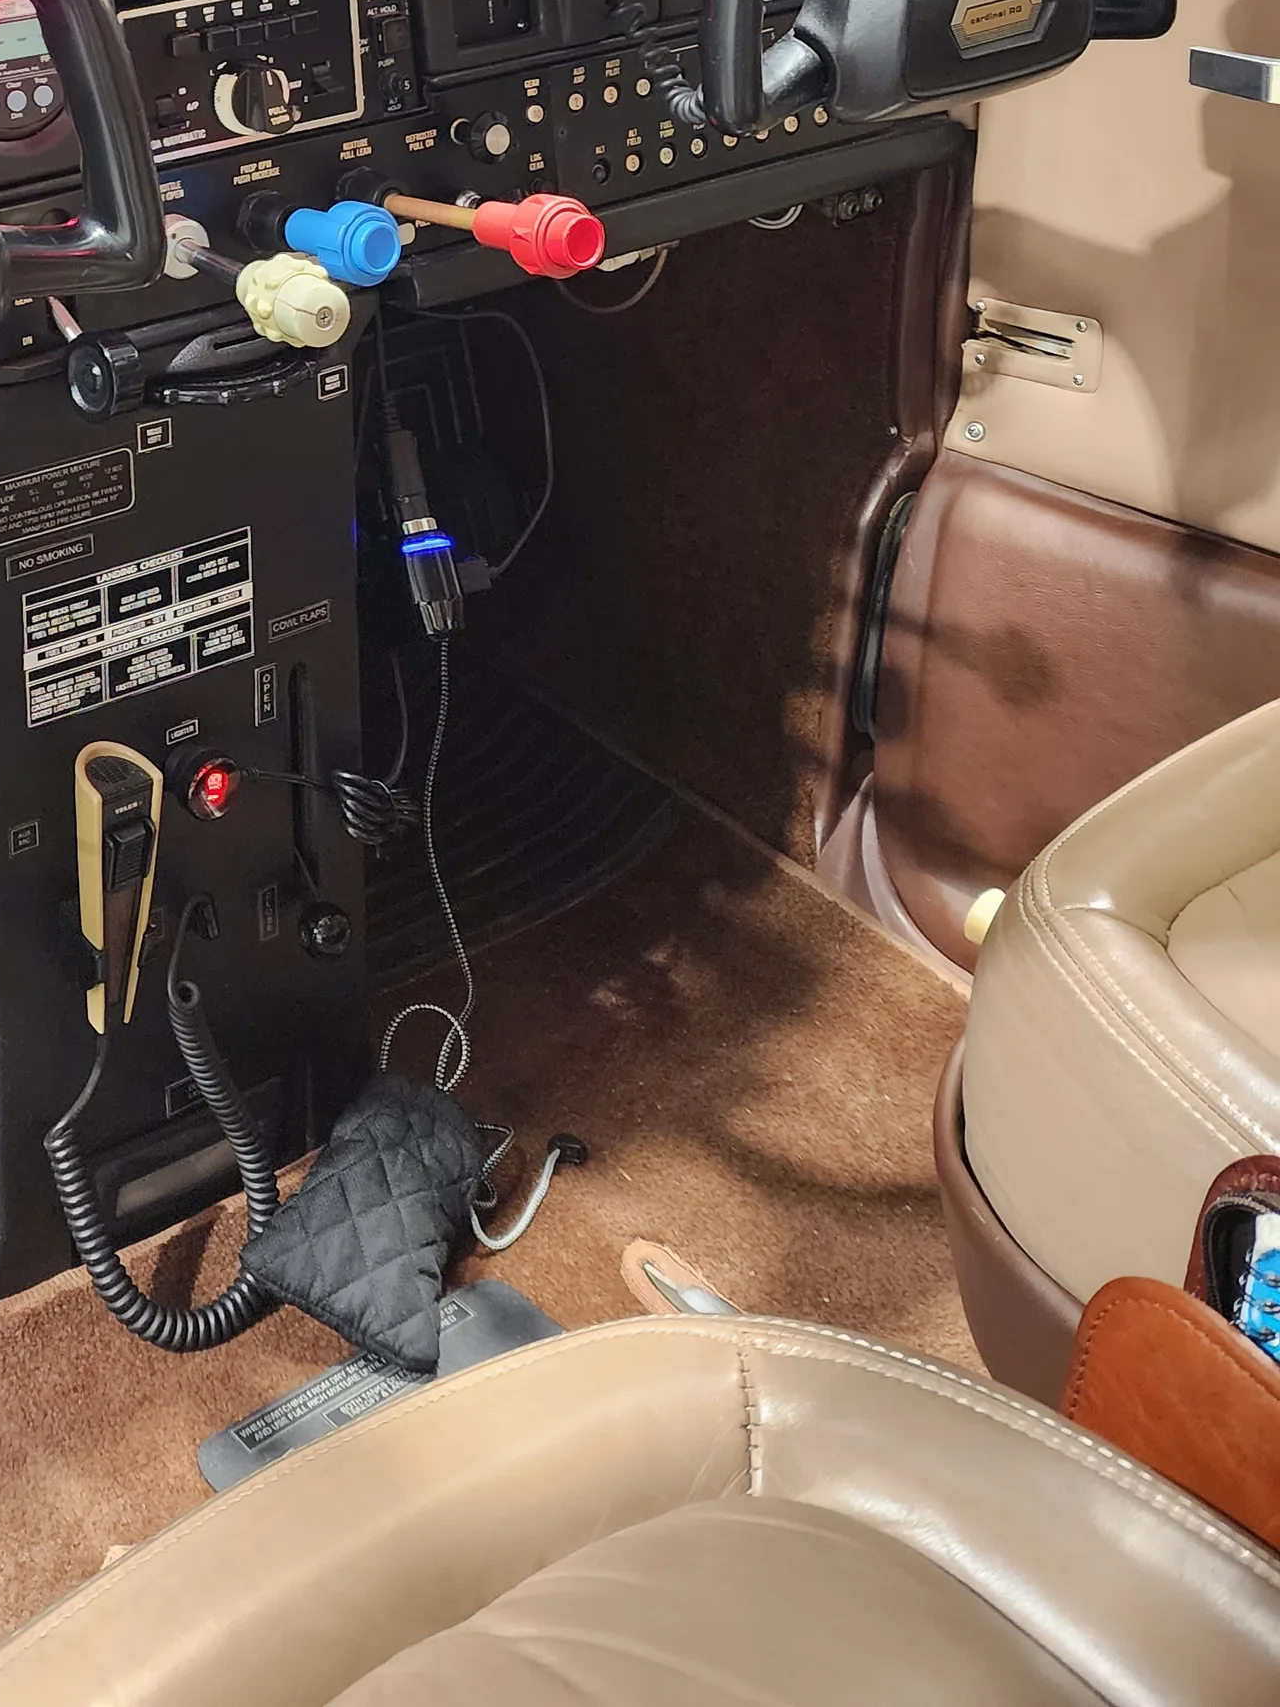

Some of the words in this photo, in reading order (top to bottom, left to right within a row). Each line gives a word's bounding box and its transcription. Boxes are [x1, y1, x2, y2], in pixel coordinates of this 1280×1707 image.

[367, 5, 380, 16] ALT
[380, 4, 397, 13] HOLD
[970, 9, 1006, 25] cardinal
[378, 58, 395, 68] PUSH
[627, 128, 638, 139] ALT
[659, 120, 673, 131] FUEL
[626, 136, 642, 147] FIELD
[528, 160, 545, 172] GEAR
[4, 475, 41, 492] MAXIMUM
[41, 468, 69, 482] POWER
[69, 459, 102, 474] MIXTURE
[9, 504, 53, 522] CONTINUOUS
[53, 493, 91, 511] OPERATION
[18, 558, 35, 570] NO
[36, 543, 84, 564] SMOKING
[96, 565, 138, 584] LANDING
[139, 550, 184, 571] CHECKLIST
[272, 618, 299, 633] COWL
[299, 606, 328, 623] FLAPS
[101, 641, 139, 658] TAKEOFF
[140, 625, 185, 646] CHECKLIST
[262, 673, 271, 712] OPEN
[287, 1404, 310, 1423] FULL
[325, 1373, 361, 1402] MIXTURE
[240, 1419, 265, 1438] WHEN
[264, 1395, 308, 1425] SWITCHING
